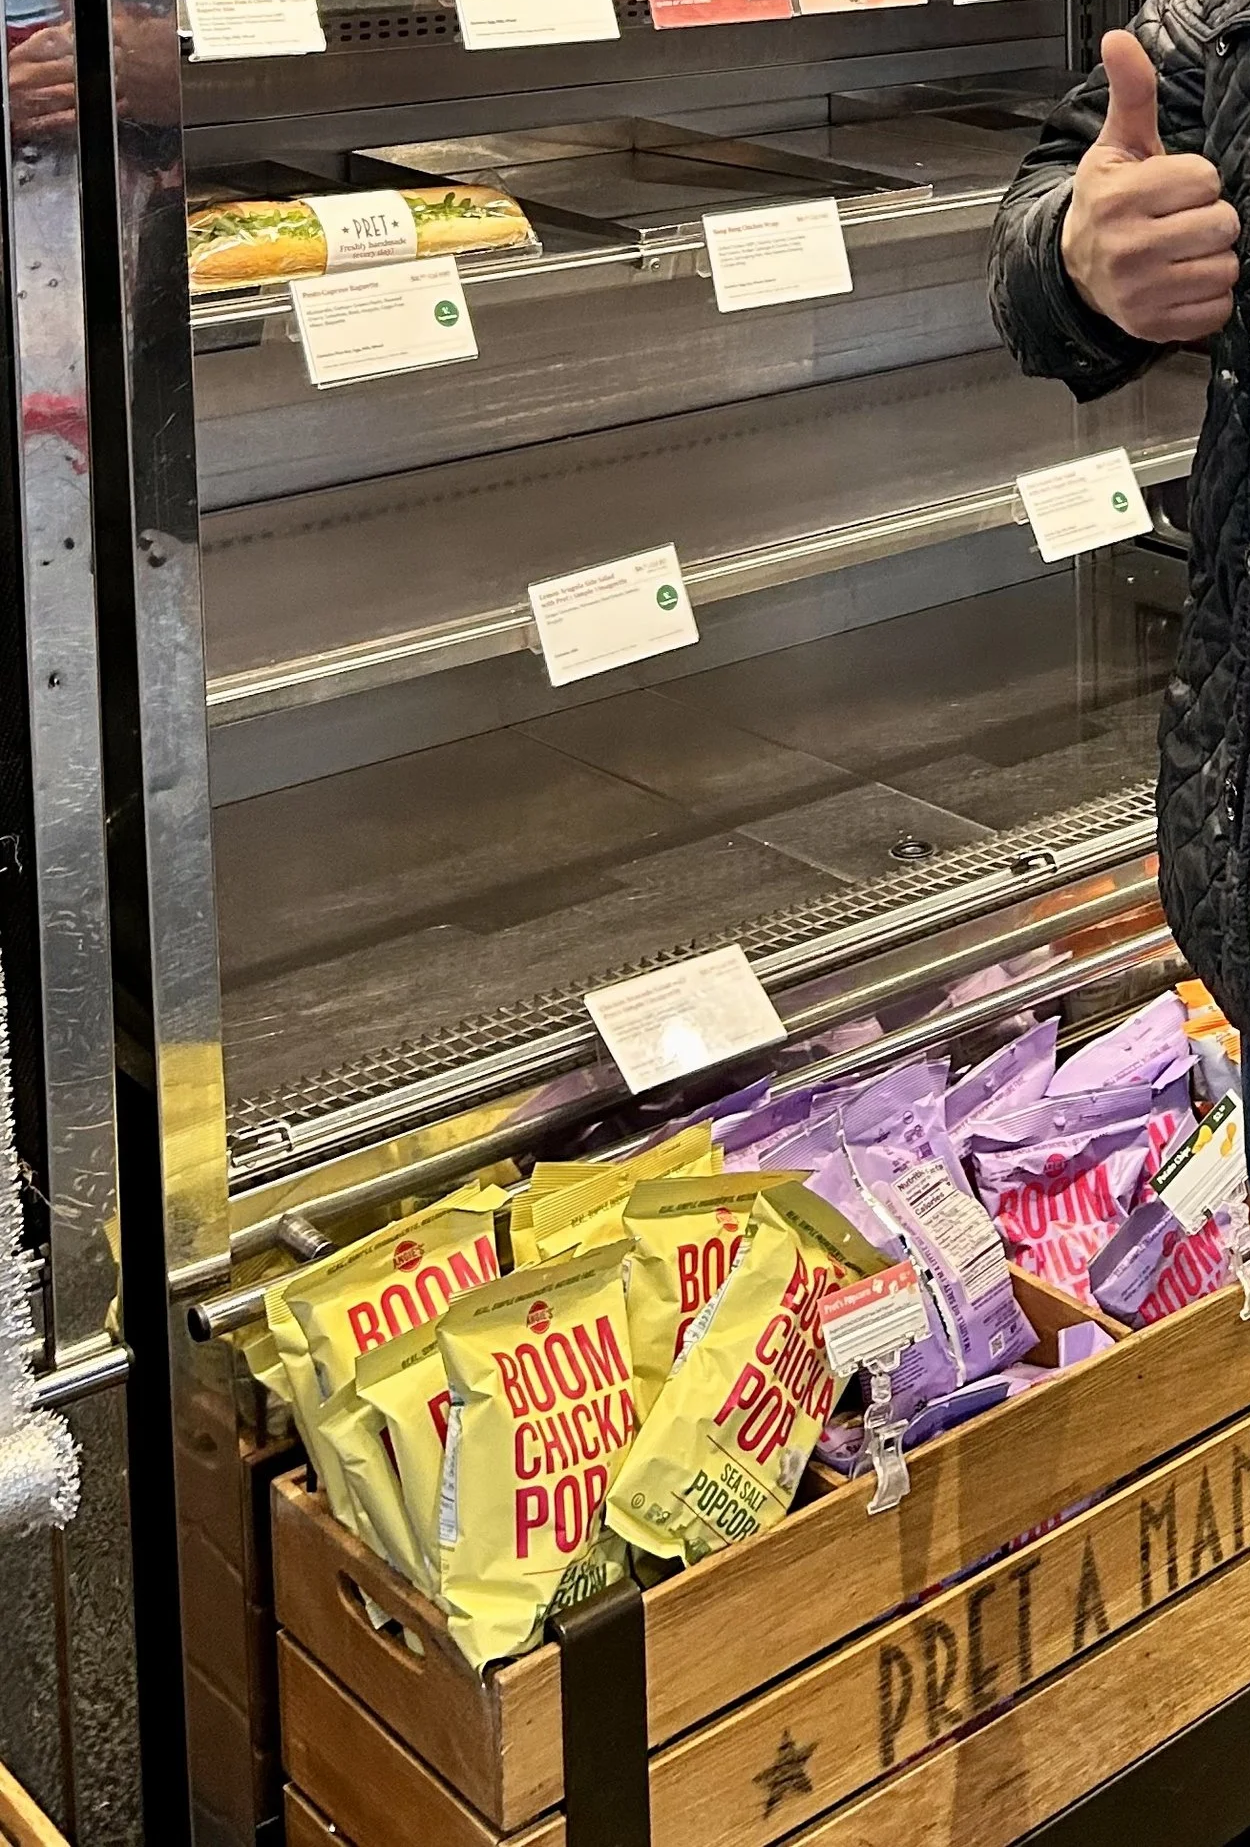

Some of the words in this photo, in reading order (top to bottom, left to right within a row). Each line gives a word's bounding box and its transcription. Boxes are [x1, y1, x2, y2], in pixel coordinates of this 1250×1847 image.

[340, 242, 365, 253] Freshly
[368, 238, 407, 248] handmade
[352, 215, 388, 239] PRET
[915, 1192, 945, 1216] Calories
[347, 1235, 498, 1354] BOOM
[491, 1315, 630, 1419] BOOM
[756, 1314, 833, 1424] CHICKA
[514, 1388, 636, 1480] CHICKA
[713, 1366, 796, 1465] POP
[515, 1464, 608, 1559] POP
[720, 1463, 743, 1493] SEA
[739, 1481, 767, 1512] SALT
[877, 1557, 1042, 1769] PRET
[1072, 1535, 1111, 1653] A
